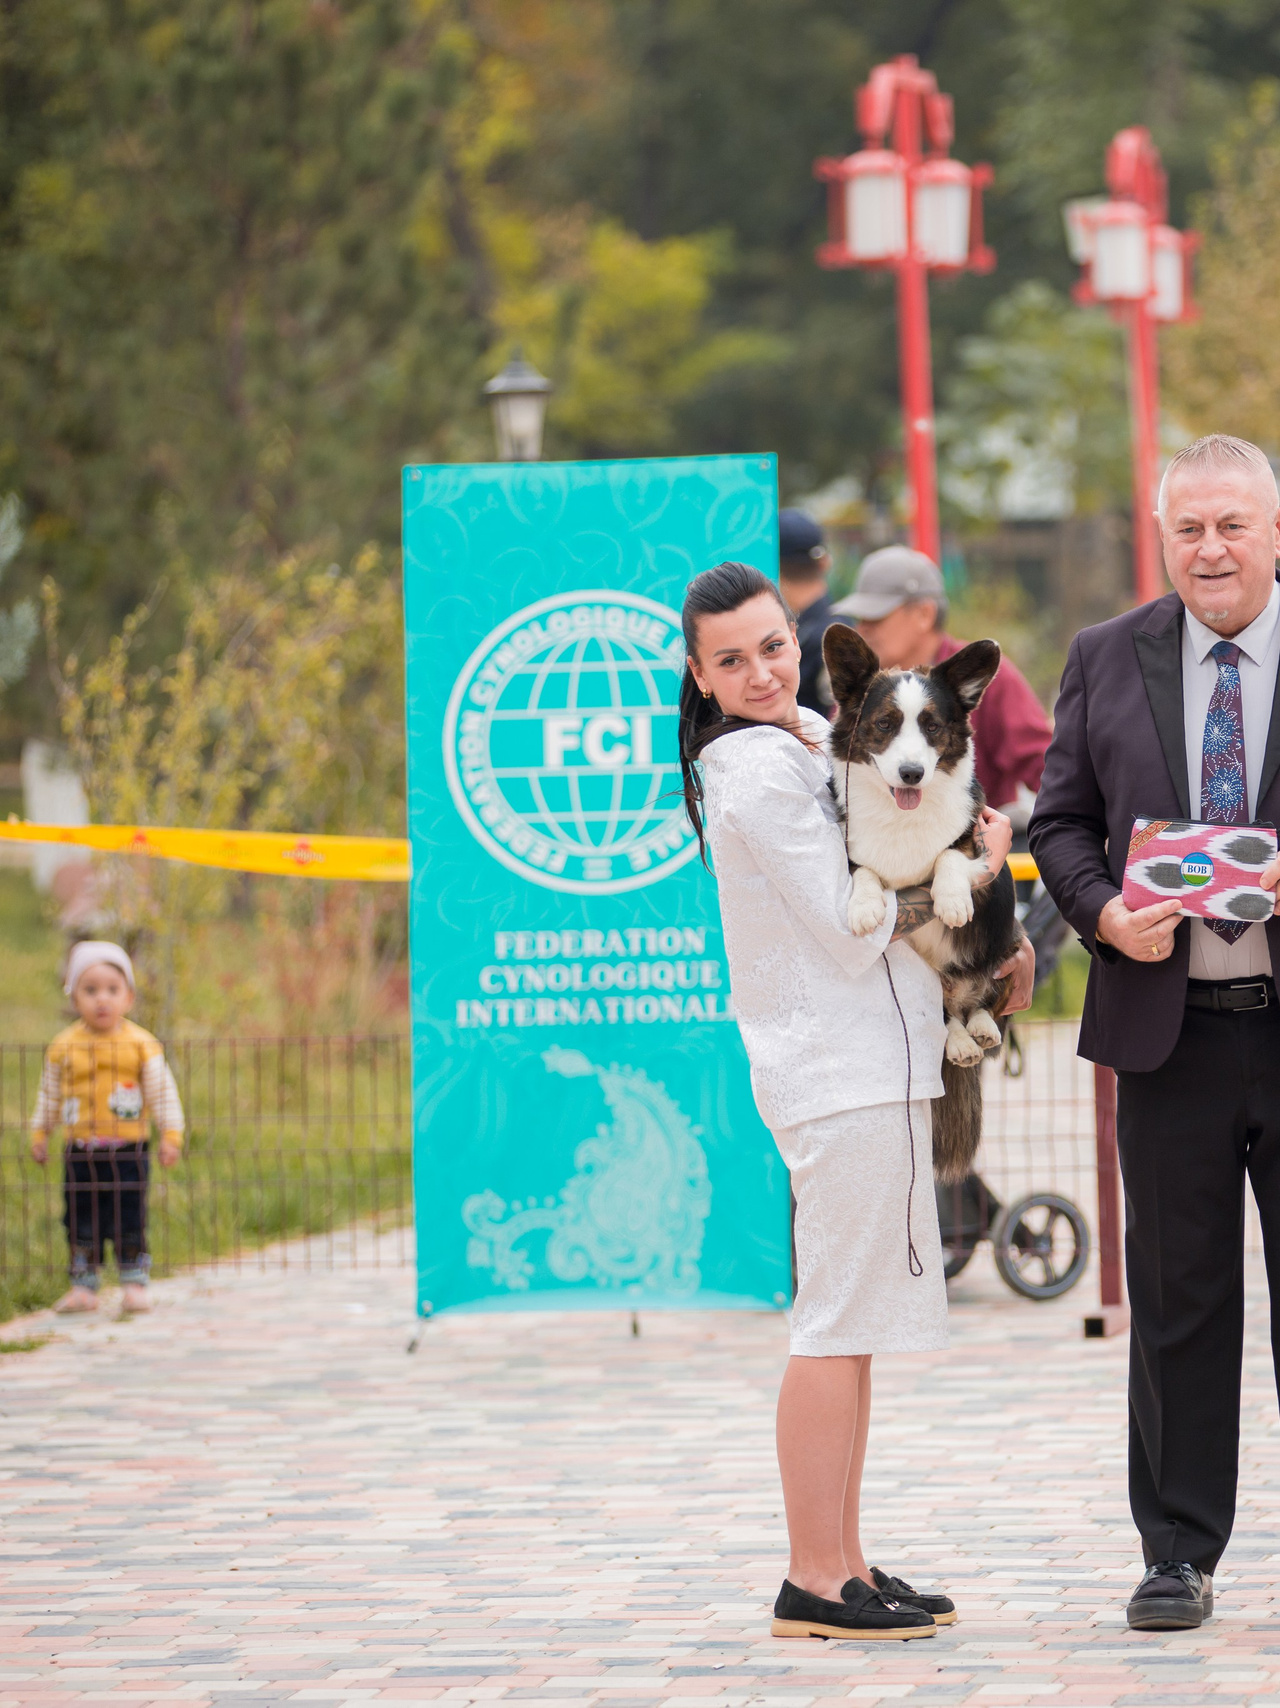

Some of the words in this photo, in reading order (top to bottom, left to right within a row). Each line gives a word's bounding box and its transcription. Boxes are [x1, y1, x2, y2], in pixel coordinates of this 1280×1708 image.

[469, 605, 668, 706] CYNOLOGIQUE
[543, 713, 653, 770] FCI
[1187, 864, 1207, 875] BOB
[494, 926, 706, 961] FEDERATION
[478, 960, 722, 995] CYNOLOGIQUE
